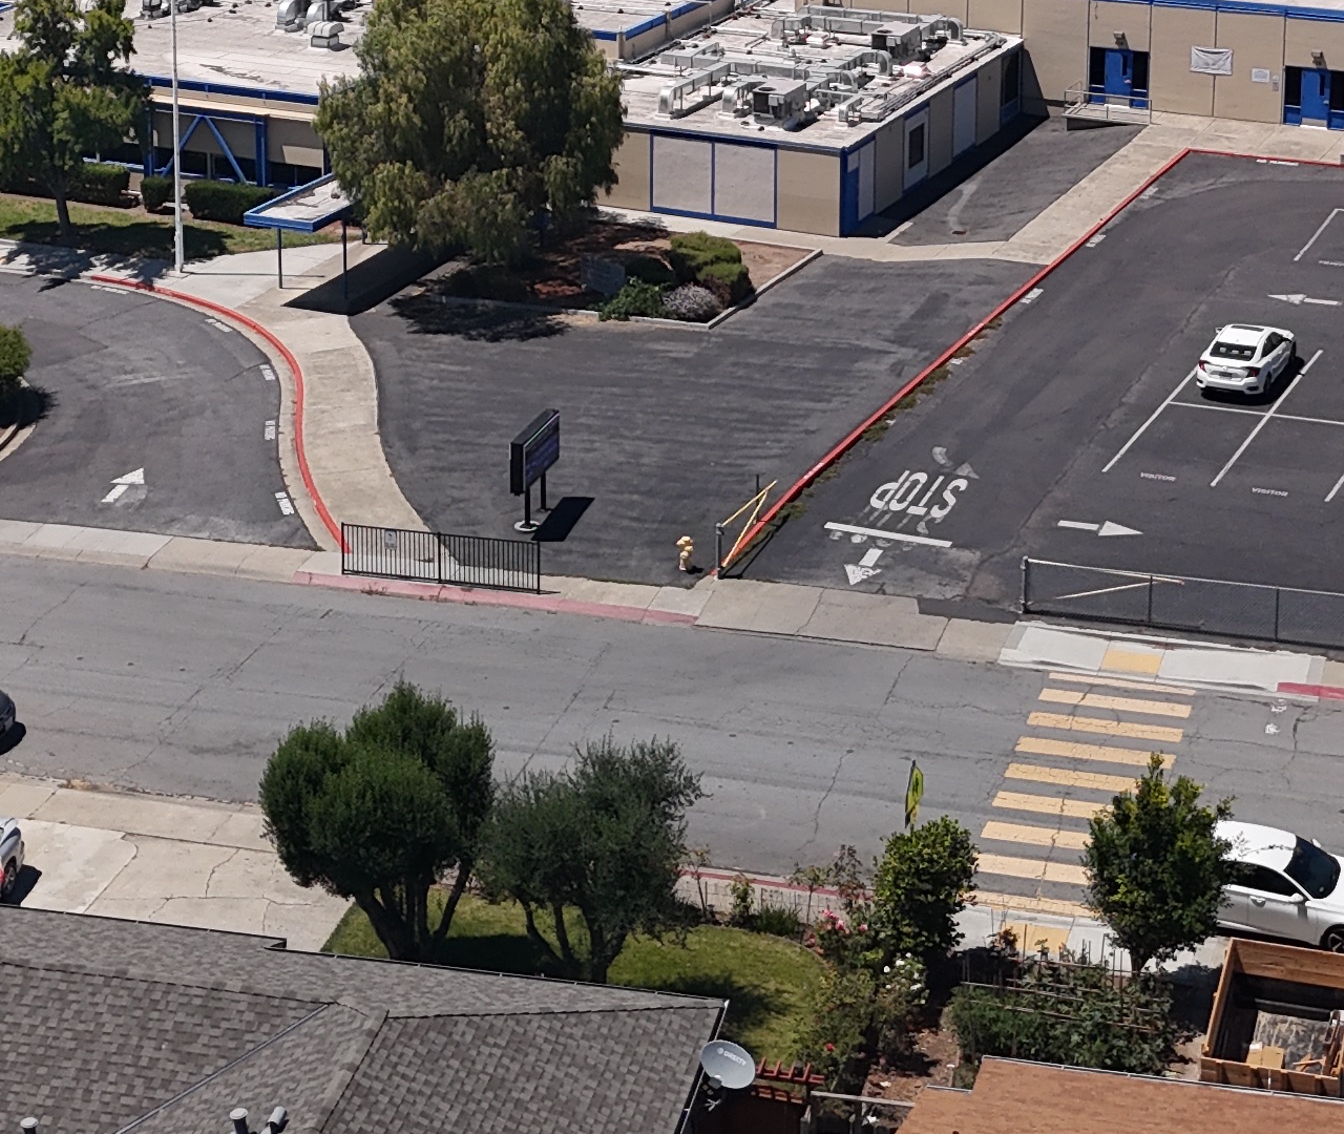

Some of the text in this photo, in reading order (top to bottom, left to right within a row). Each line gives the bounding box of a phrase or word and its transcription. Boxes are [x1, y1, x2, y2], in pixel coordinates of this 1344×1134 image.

[1140, 471, 1177, 482] VISITOR
[869, 470, 969, 519] STOP
[1251, 486, 1289, 497] VISITOR
